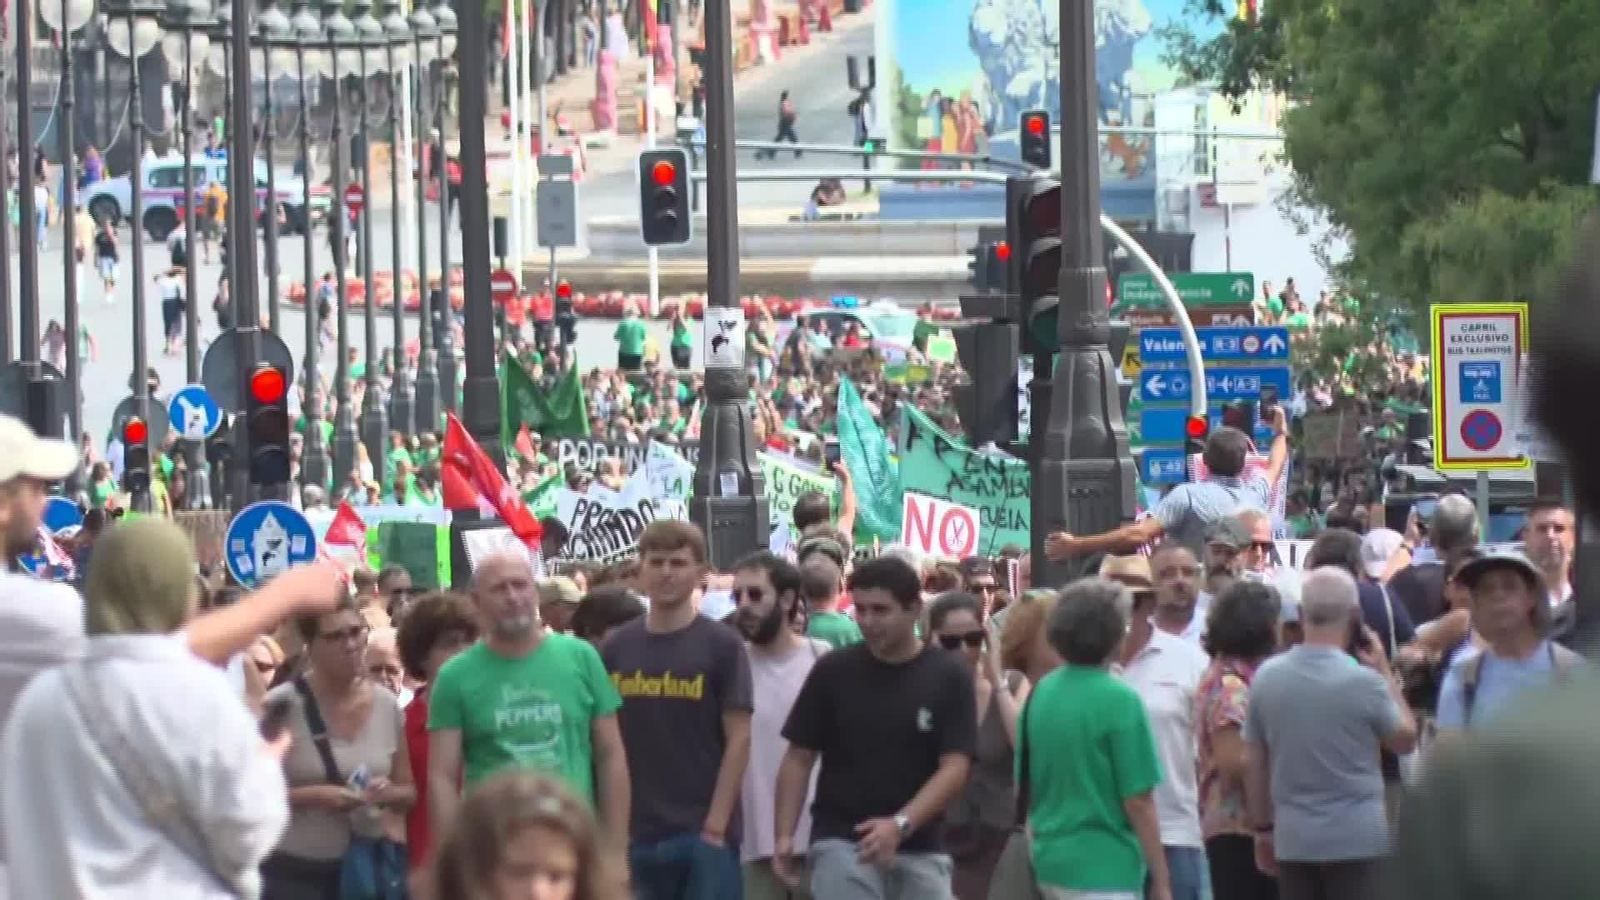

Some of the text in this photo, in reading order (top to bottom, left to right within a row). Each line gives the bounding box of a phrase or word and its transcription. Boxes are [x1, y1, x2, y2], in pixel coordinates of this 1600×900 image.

[1460, 323, 1497, 332] CARRIL
[1144, 337, 1207, 352] Valena
[1450, 333, 1509, 344] EXCLUSIVO
[904, 497, 975, 560] NO
